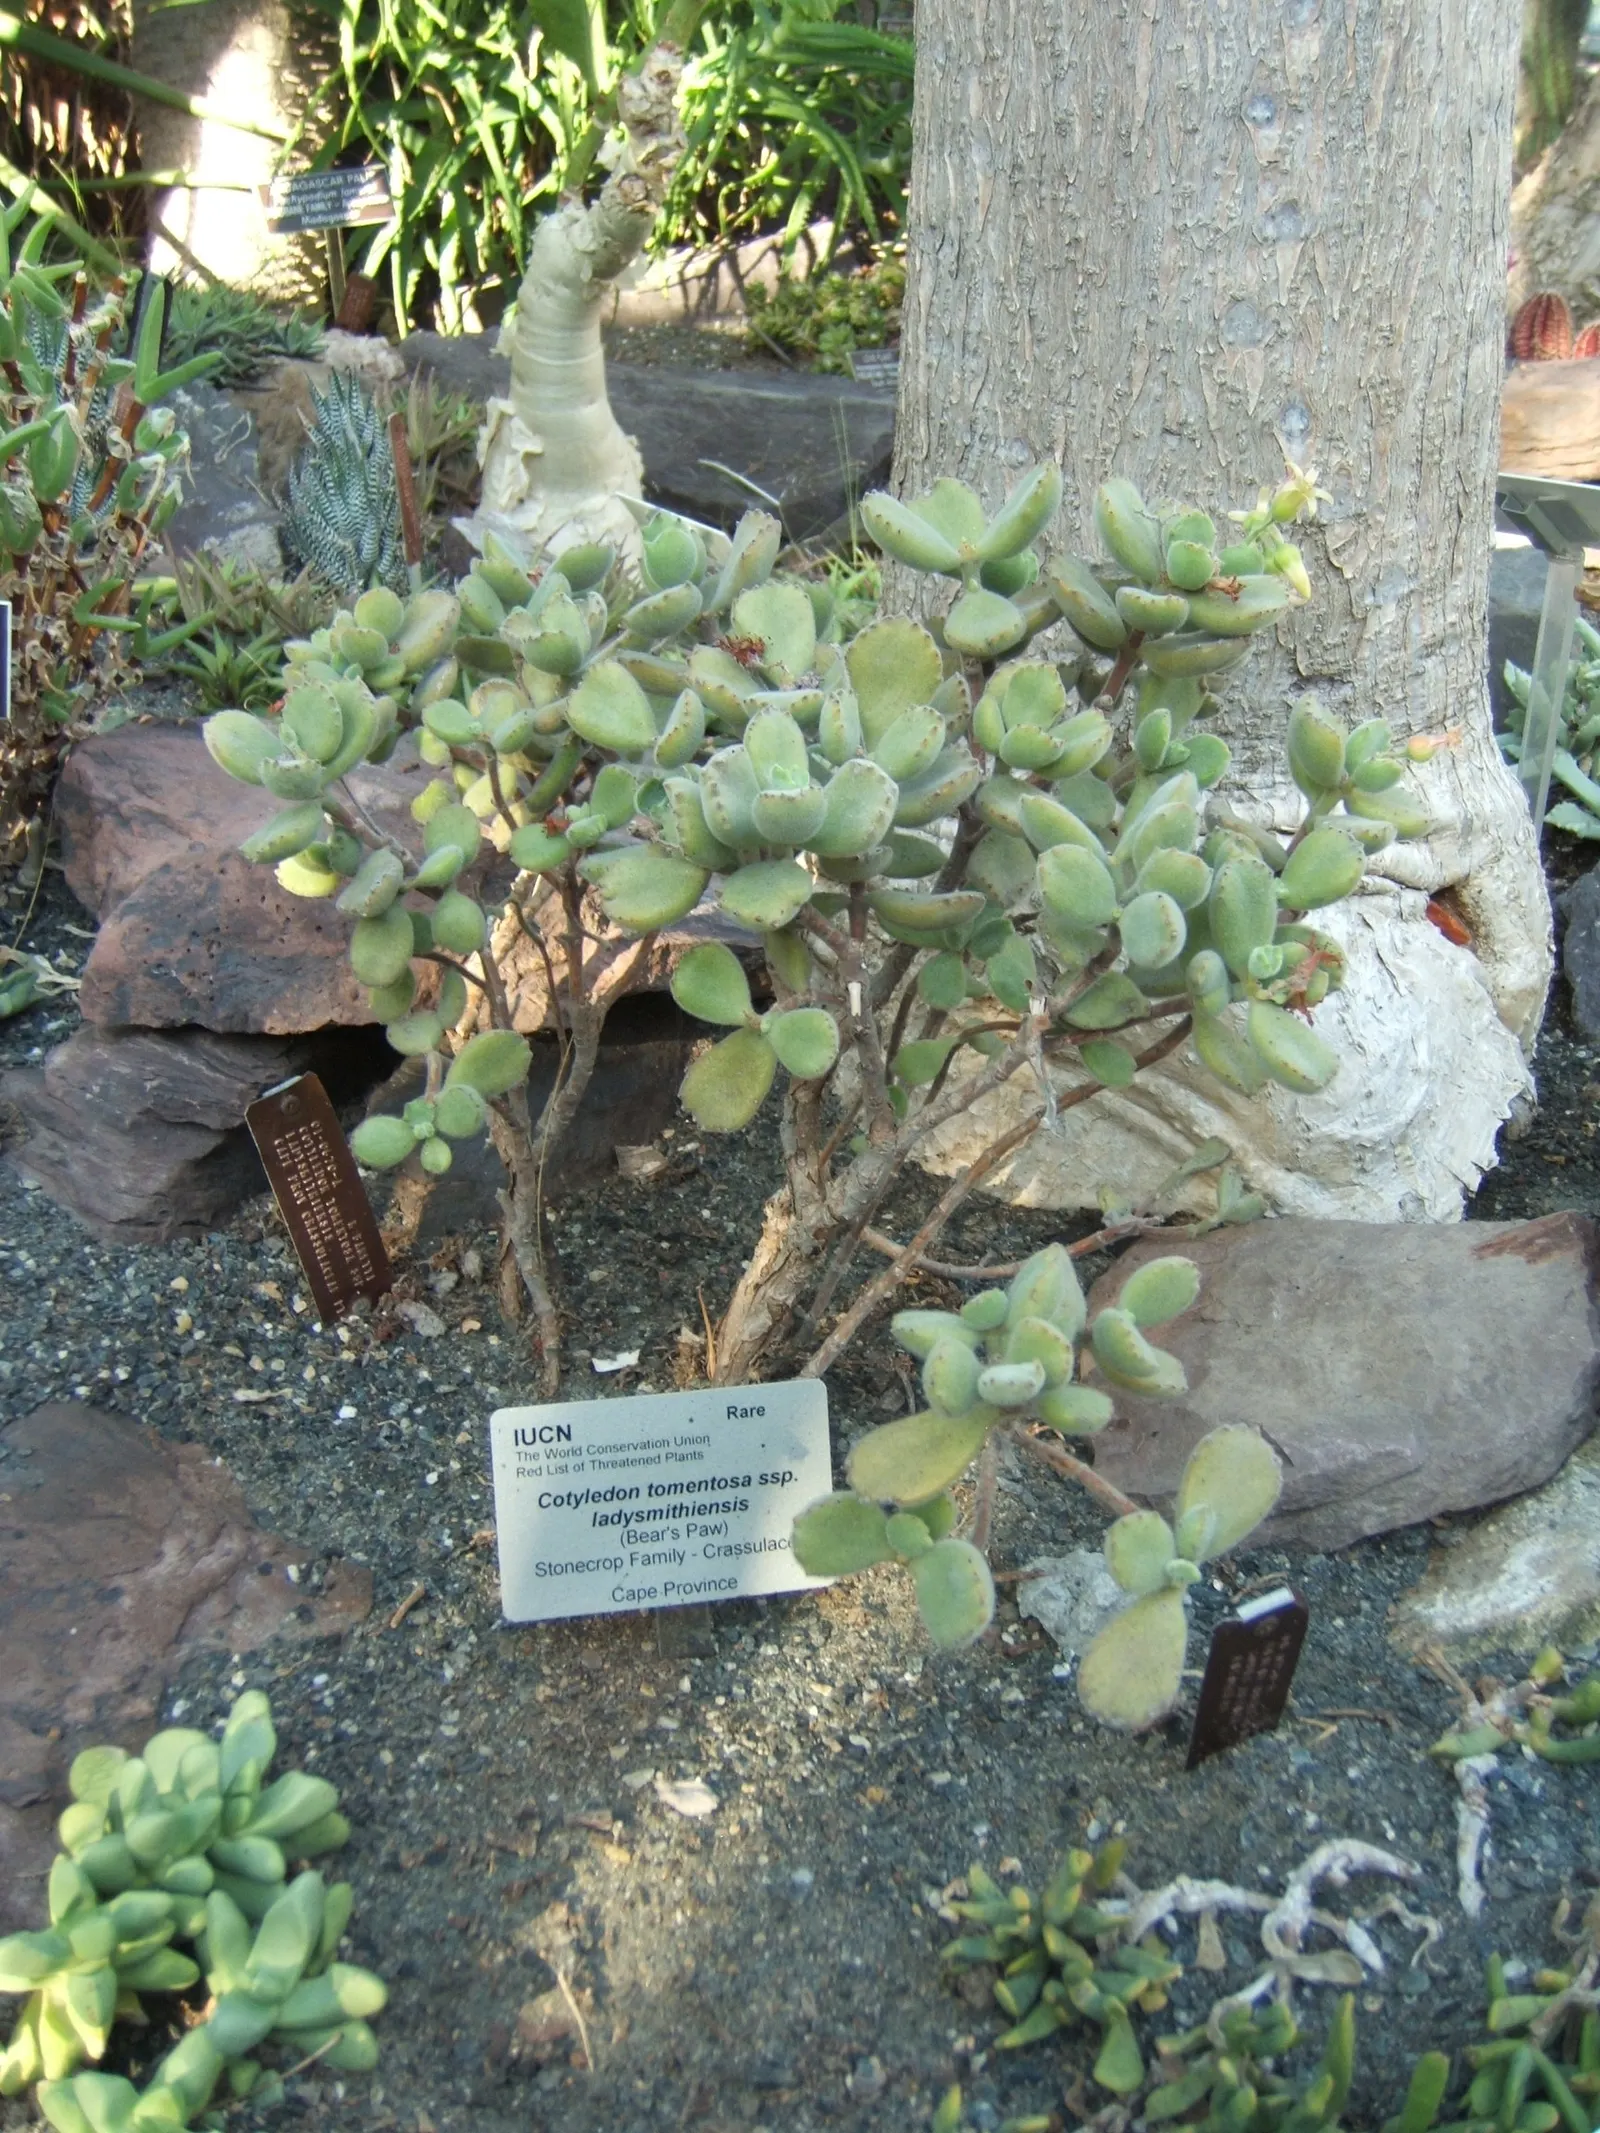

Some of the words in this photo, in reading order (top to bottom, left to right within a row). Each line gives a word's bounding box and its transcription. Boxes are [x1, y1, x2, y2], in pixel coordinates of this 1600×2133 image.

[726, 1405, 766, 1420] Rare
[514, 1423, 572, 1447] IUCN
[516, 1451, 540, 1462] The
[544, 1445, 583, 1460] World
[586, 1437, 670, 1456] Conservation
[674, 1434, 710, 1447] Union
[516, 1465, 542, 1479] Red
[546, 1463, 569, 1476] List
[572, 1460, 586, 1473] of
[589, 1454, 661, 1471] Threatened
[665, 1450, 704, 1463] Plants
[538, 1485, 640, 1510] Cotyledon
[647, 1474, 752, 1498] tomentosa
[758, 1470, 799, 1488] ssp.
[592, 1496, 750, 1529] ladysmithiensis
[620, 1526, 681, 1549] (Bear's
[686, 1520, 729, 1539] Paw)
[535, 1556, 624, 1578] Stonecrop
[629, 1548, 686, 1567] Family
[612, 1585, 658, 1604] Cape
[664, 1577, 738, 1597] Province
